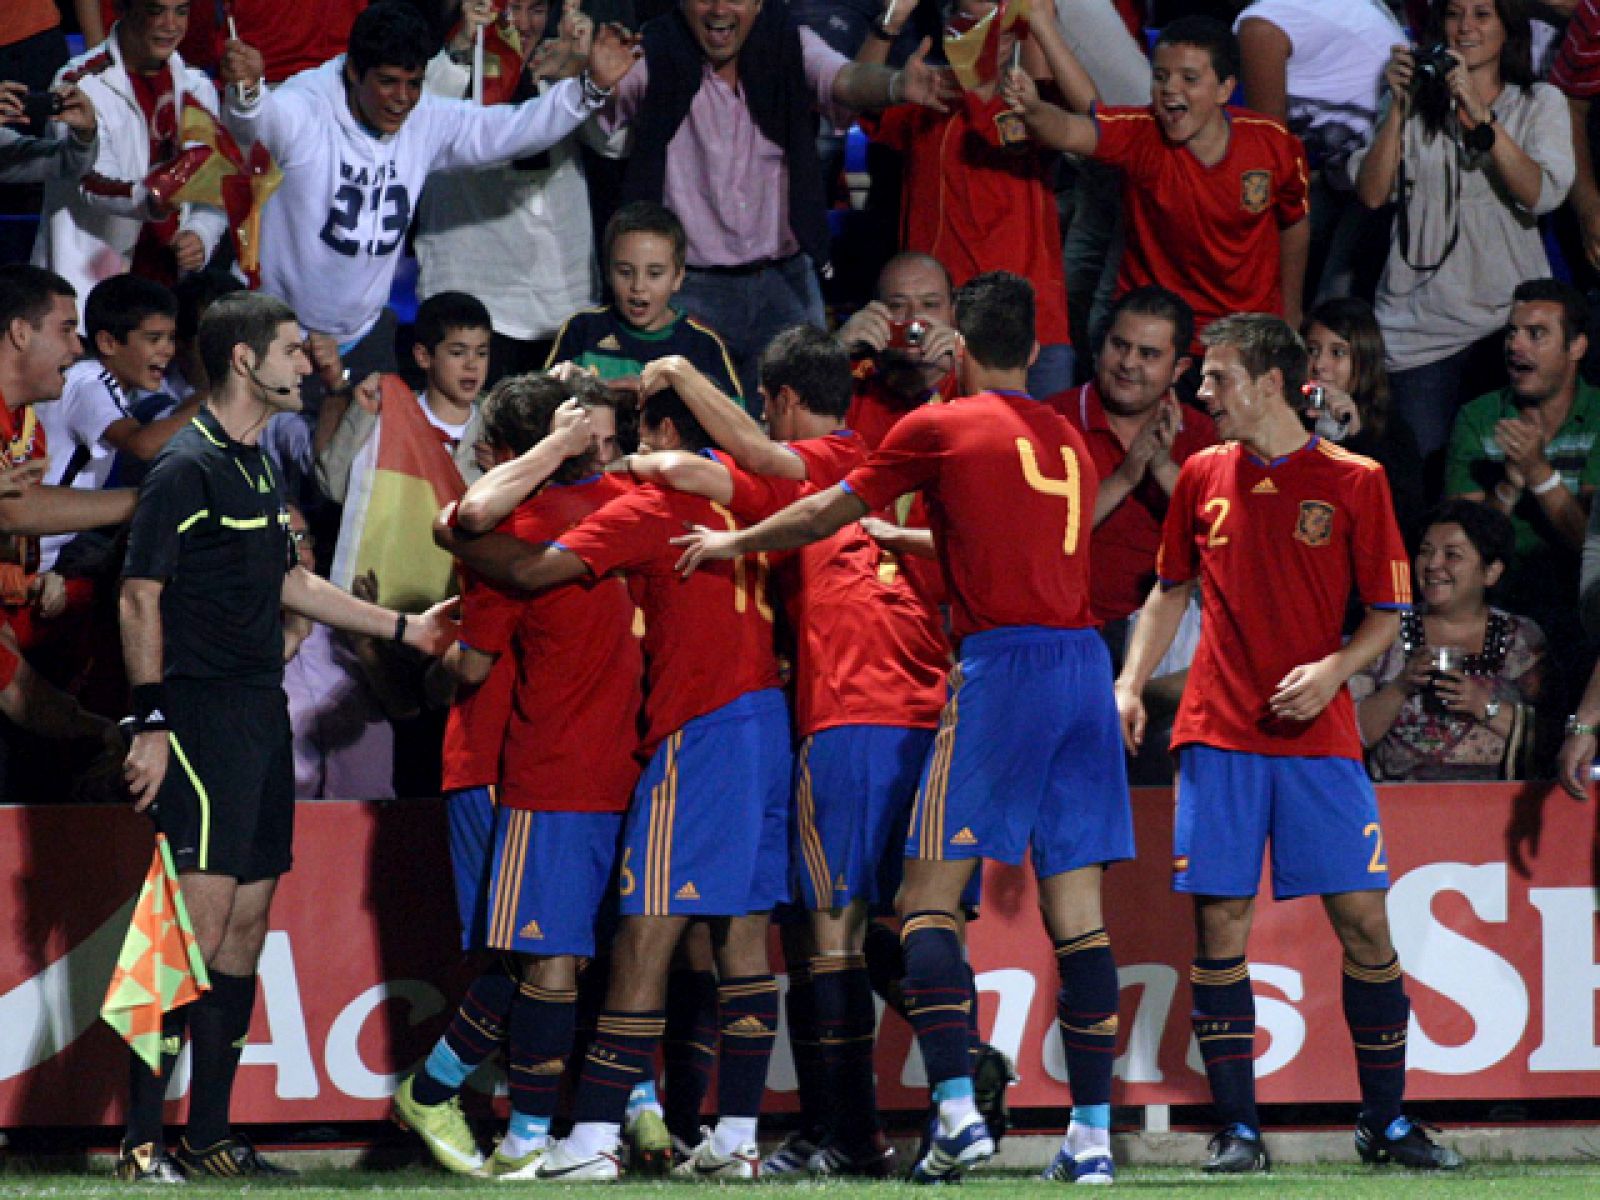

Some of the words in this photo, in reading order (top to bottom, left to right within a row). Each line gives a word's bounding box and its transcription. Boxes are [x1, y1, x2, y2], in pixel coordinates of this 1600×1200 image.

[319, 184, 410, 256] 23
[1015, 436, 1081, 555] 4
[1204, 497, 1230, 548] 2
[1362, 822, 1388, 873] 2
